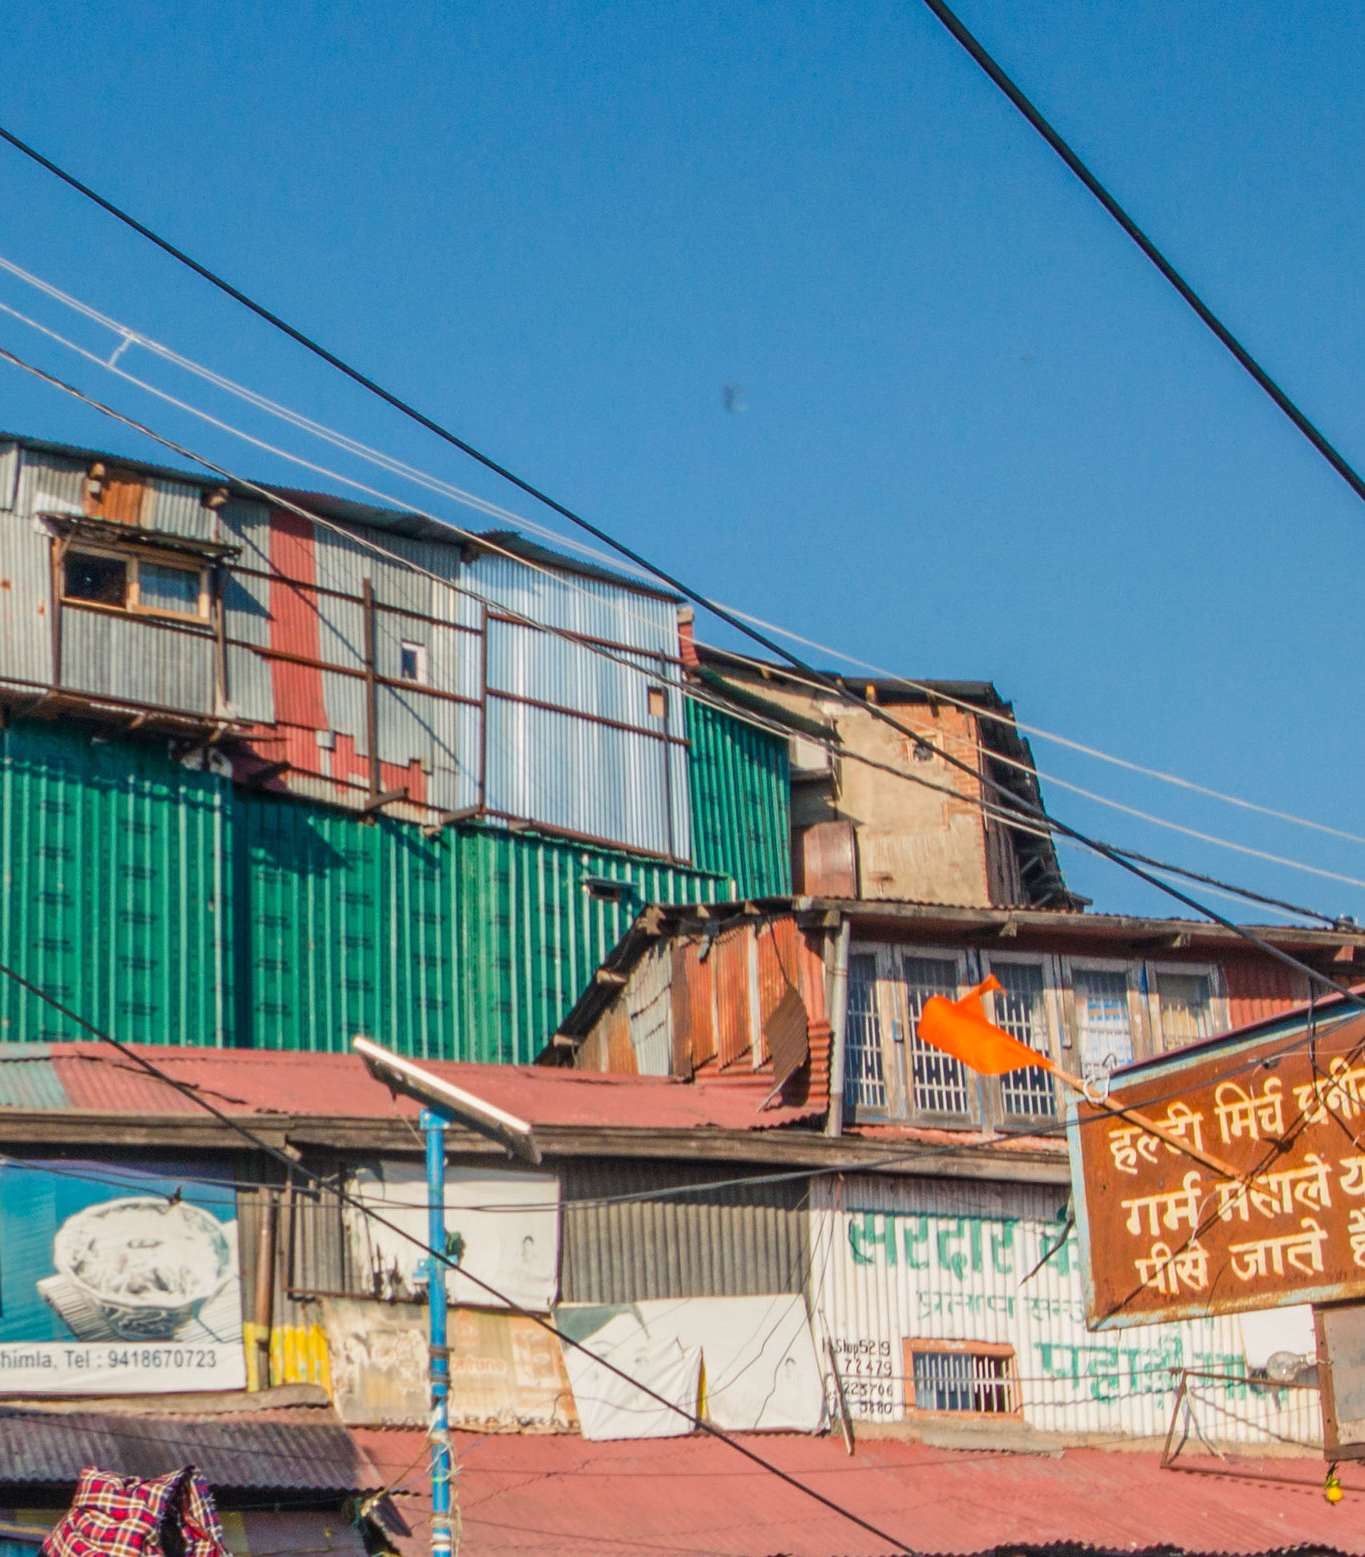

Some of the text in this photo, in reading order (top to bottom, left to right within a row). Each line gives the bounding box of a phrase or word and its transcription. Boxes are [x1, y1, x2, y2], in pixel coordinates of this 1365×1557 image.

[1122, 1173, 1201, 1236] गर्म
[1229, 1217, 1328, 1280] जाते
[65, 1350, 90, 1367] Tel
[108, 1350, 217, 1368] 9418670723
